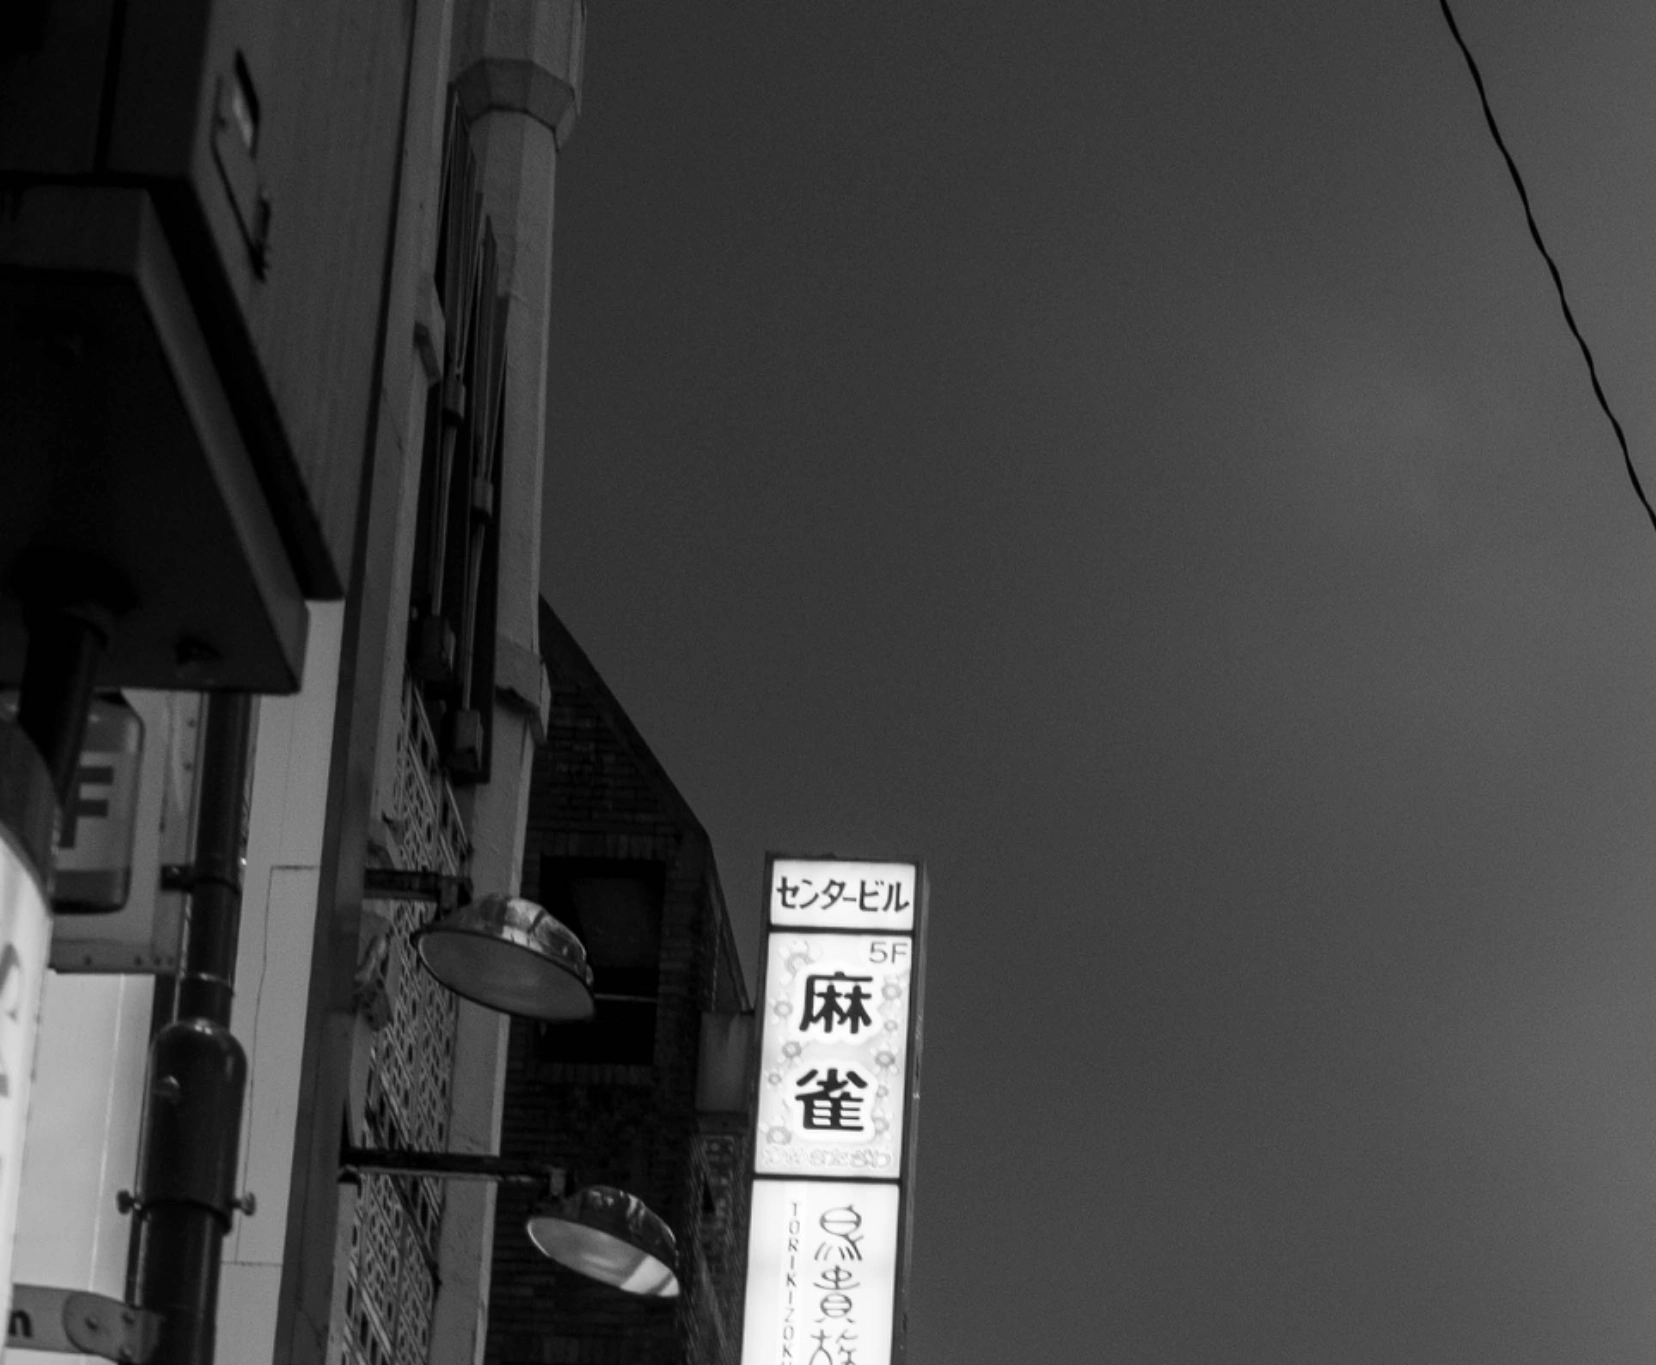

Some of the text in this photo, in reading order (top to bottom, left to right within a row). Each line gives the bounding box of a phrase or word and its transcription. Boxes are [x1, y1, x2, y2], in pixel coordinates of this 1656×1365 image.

[777, 876, 910, 914] センタービル
[869, 941, 909, 965] 5F
[794, 971, 874, 1132] 麻雀
